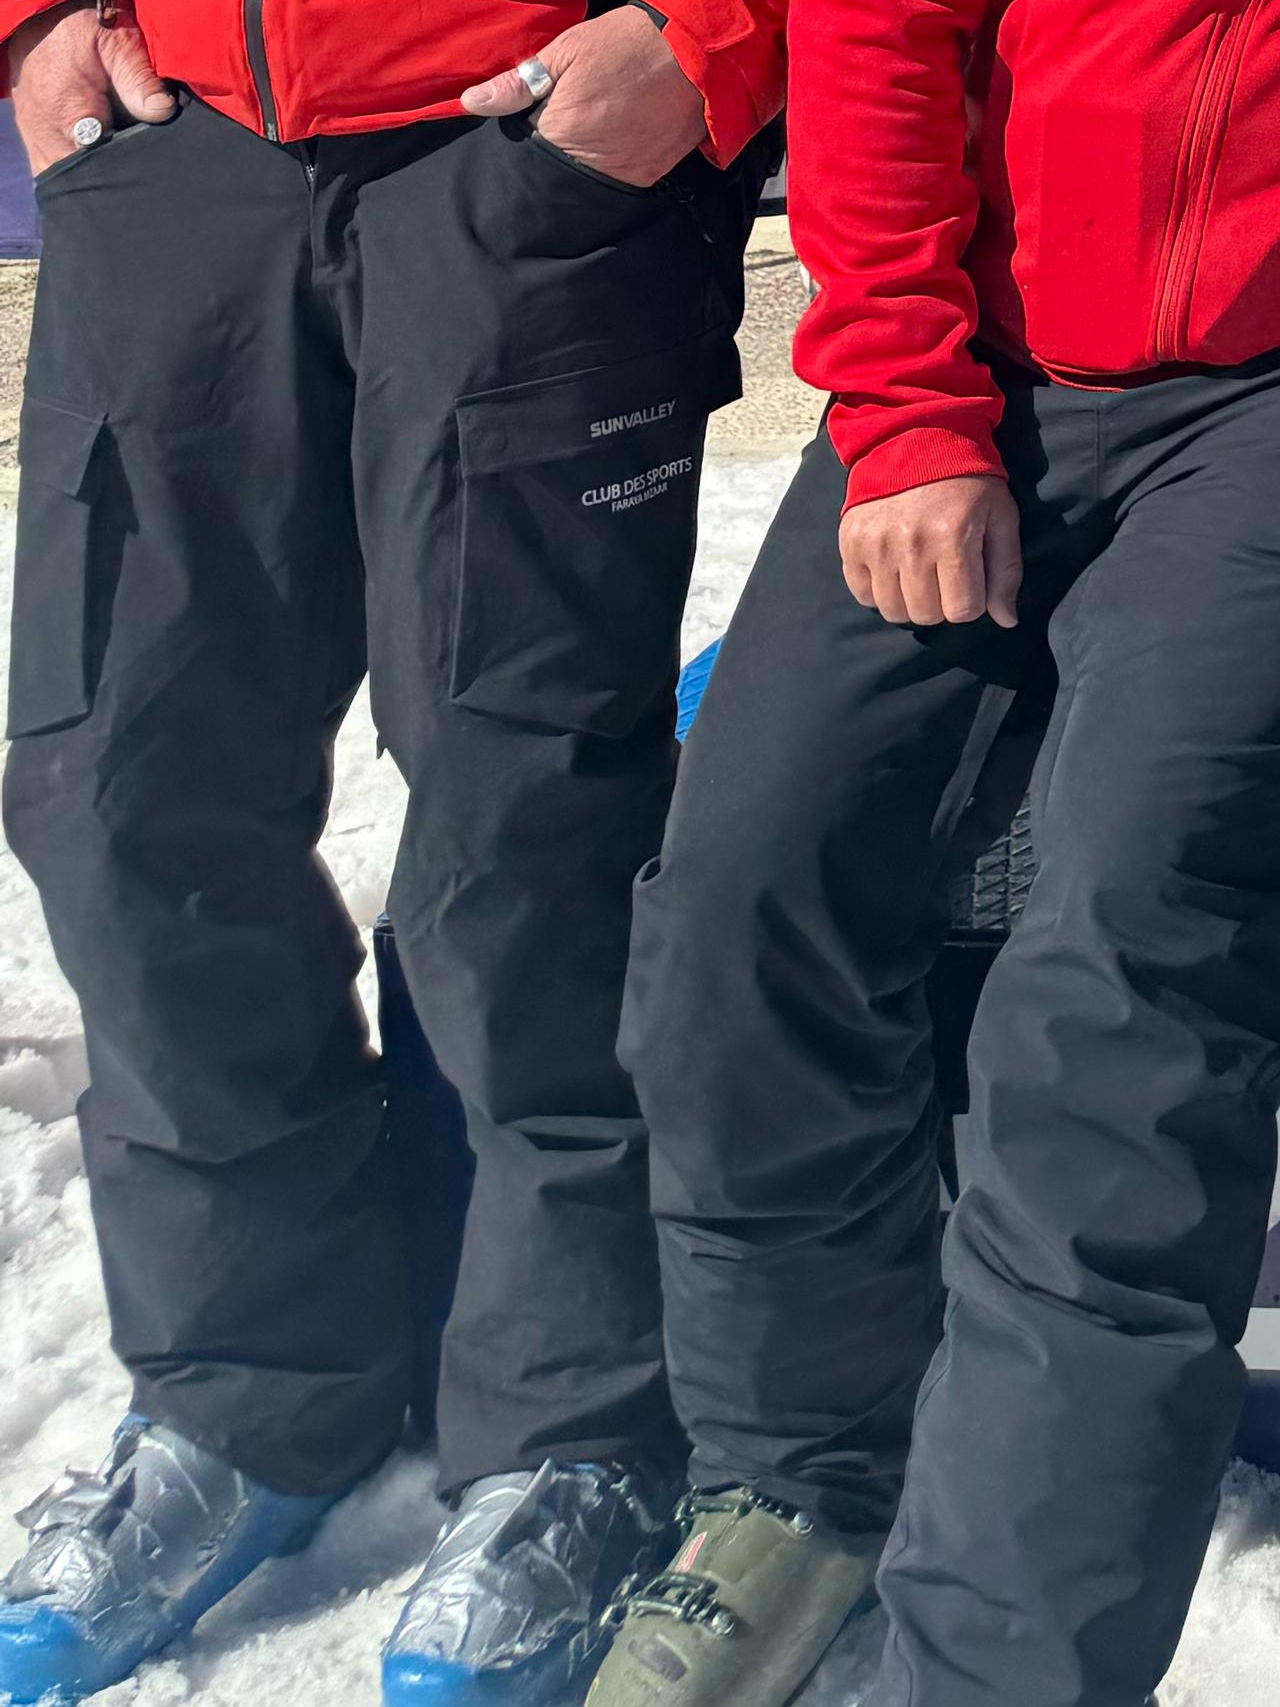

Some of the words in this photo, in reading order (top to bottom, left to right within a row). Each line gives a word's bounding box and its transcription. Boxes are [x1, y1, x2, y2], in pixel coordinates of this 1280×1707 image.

[581, 483, 621, 507] CLUB
[623, 473, 647, 498] DES
[646, 456, 693, 486] SPORTS
